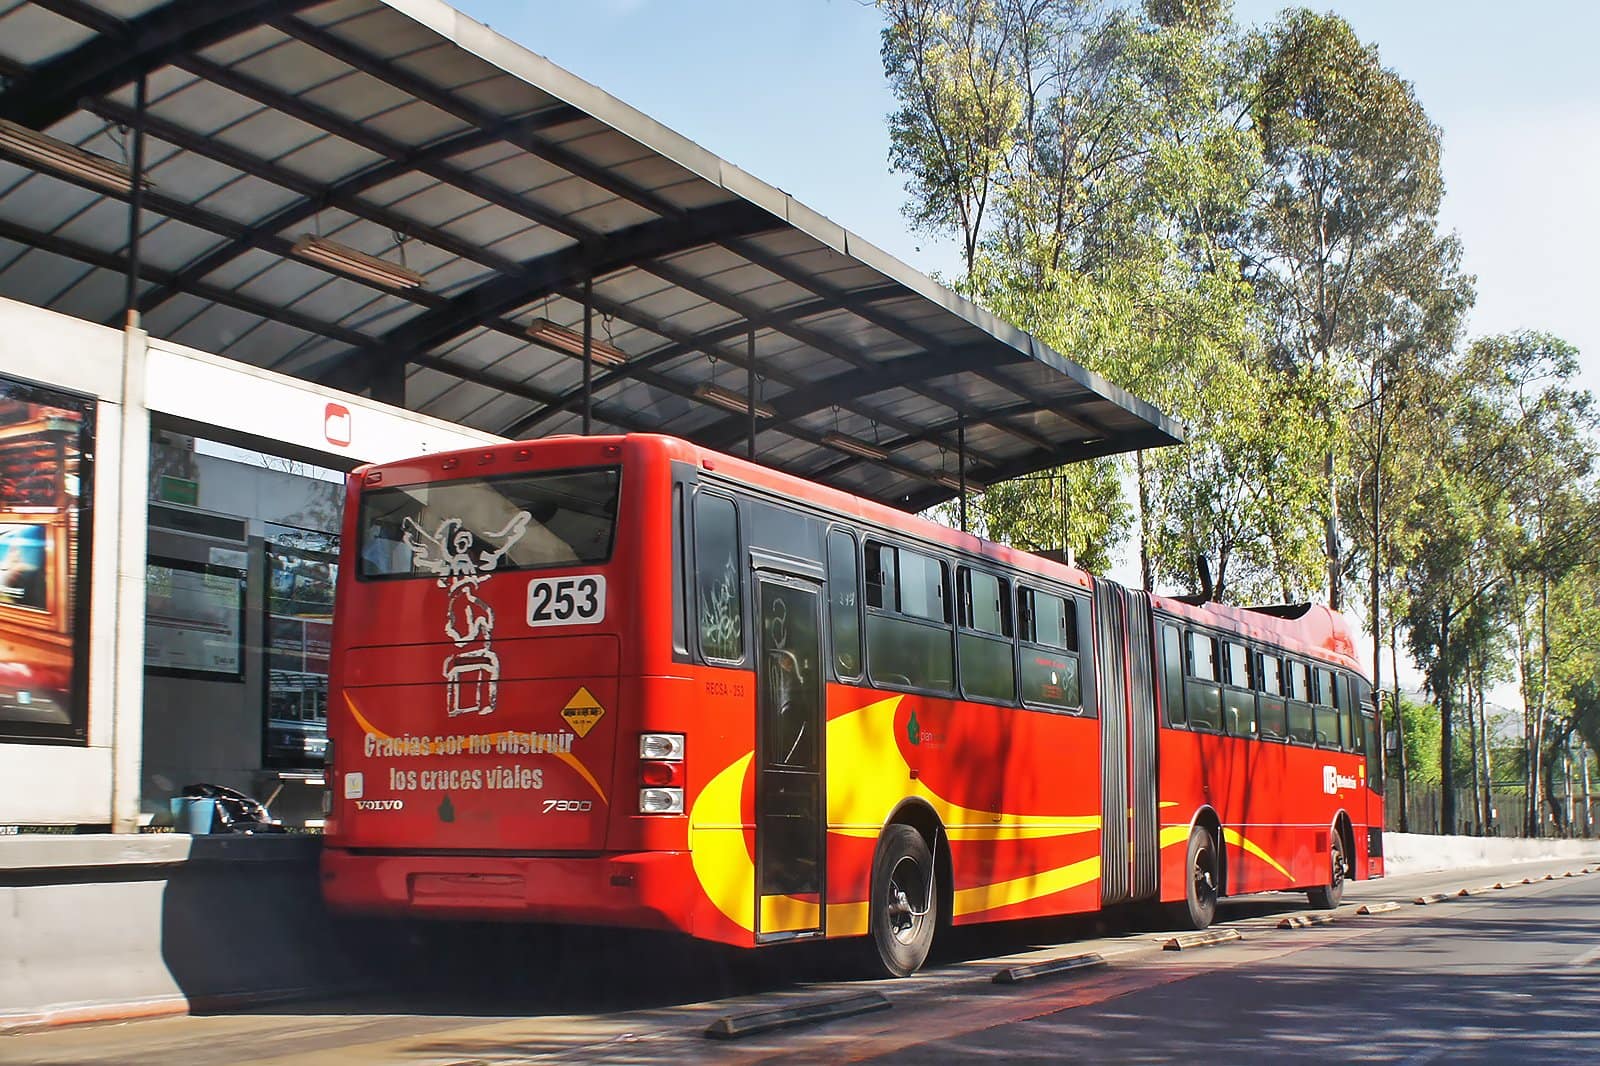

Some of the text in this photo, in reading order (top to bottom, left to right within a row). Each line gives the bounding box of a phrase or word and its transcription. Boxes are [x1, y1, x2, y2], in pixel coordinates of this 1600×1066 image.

[532, 578, 598, 621] 253
[364, 732, 431, 758] Gracias
[469, 734, 491, 755] no
[495, 729, 574, 755] obstruir
[389, 764, 544, 791] los cruces viales
[355, 799, 592, 814] VOLVO 7300
